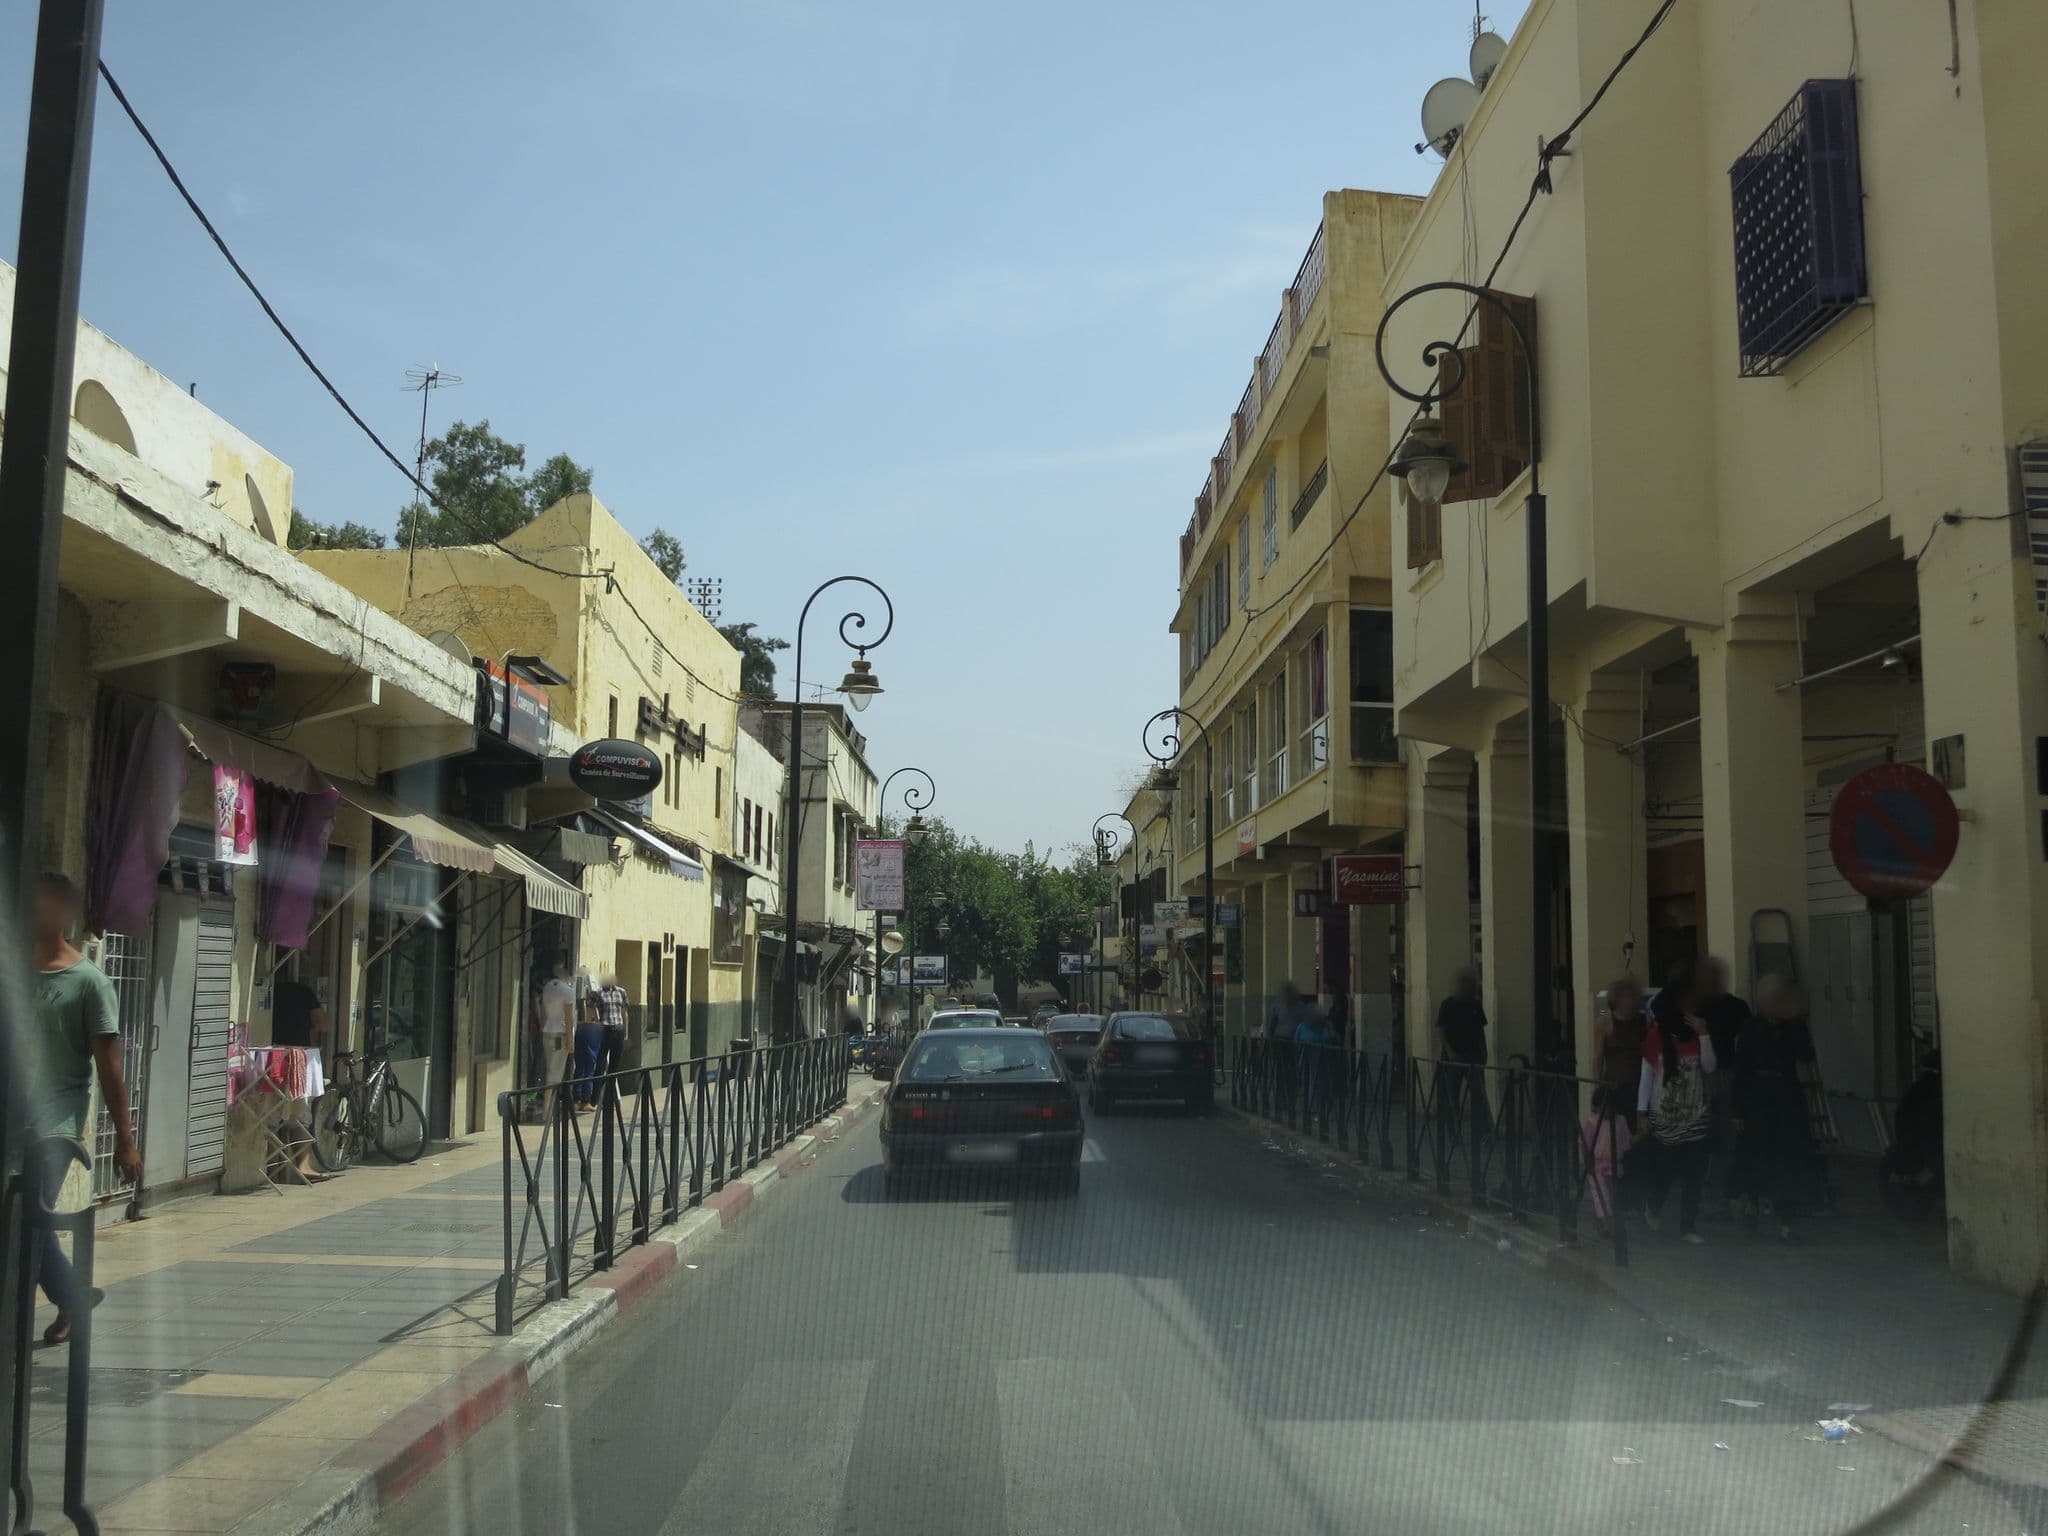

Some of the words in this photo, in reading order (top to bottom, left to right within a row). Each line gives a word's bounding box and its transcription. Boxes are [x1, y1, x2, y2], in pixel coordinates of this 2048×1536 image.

[595, 755, 651, 768] COMPUVISION
[603, 769, 611, 777] de
[611, 770, 650, 781] Surveillance
[1338, 866, 1400, 886] Yasmine
